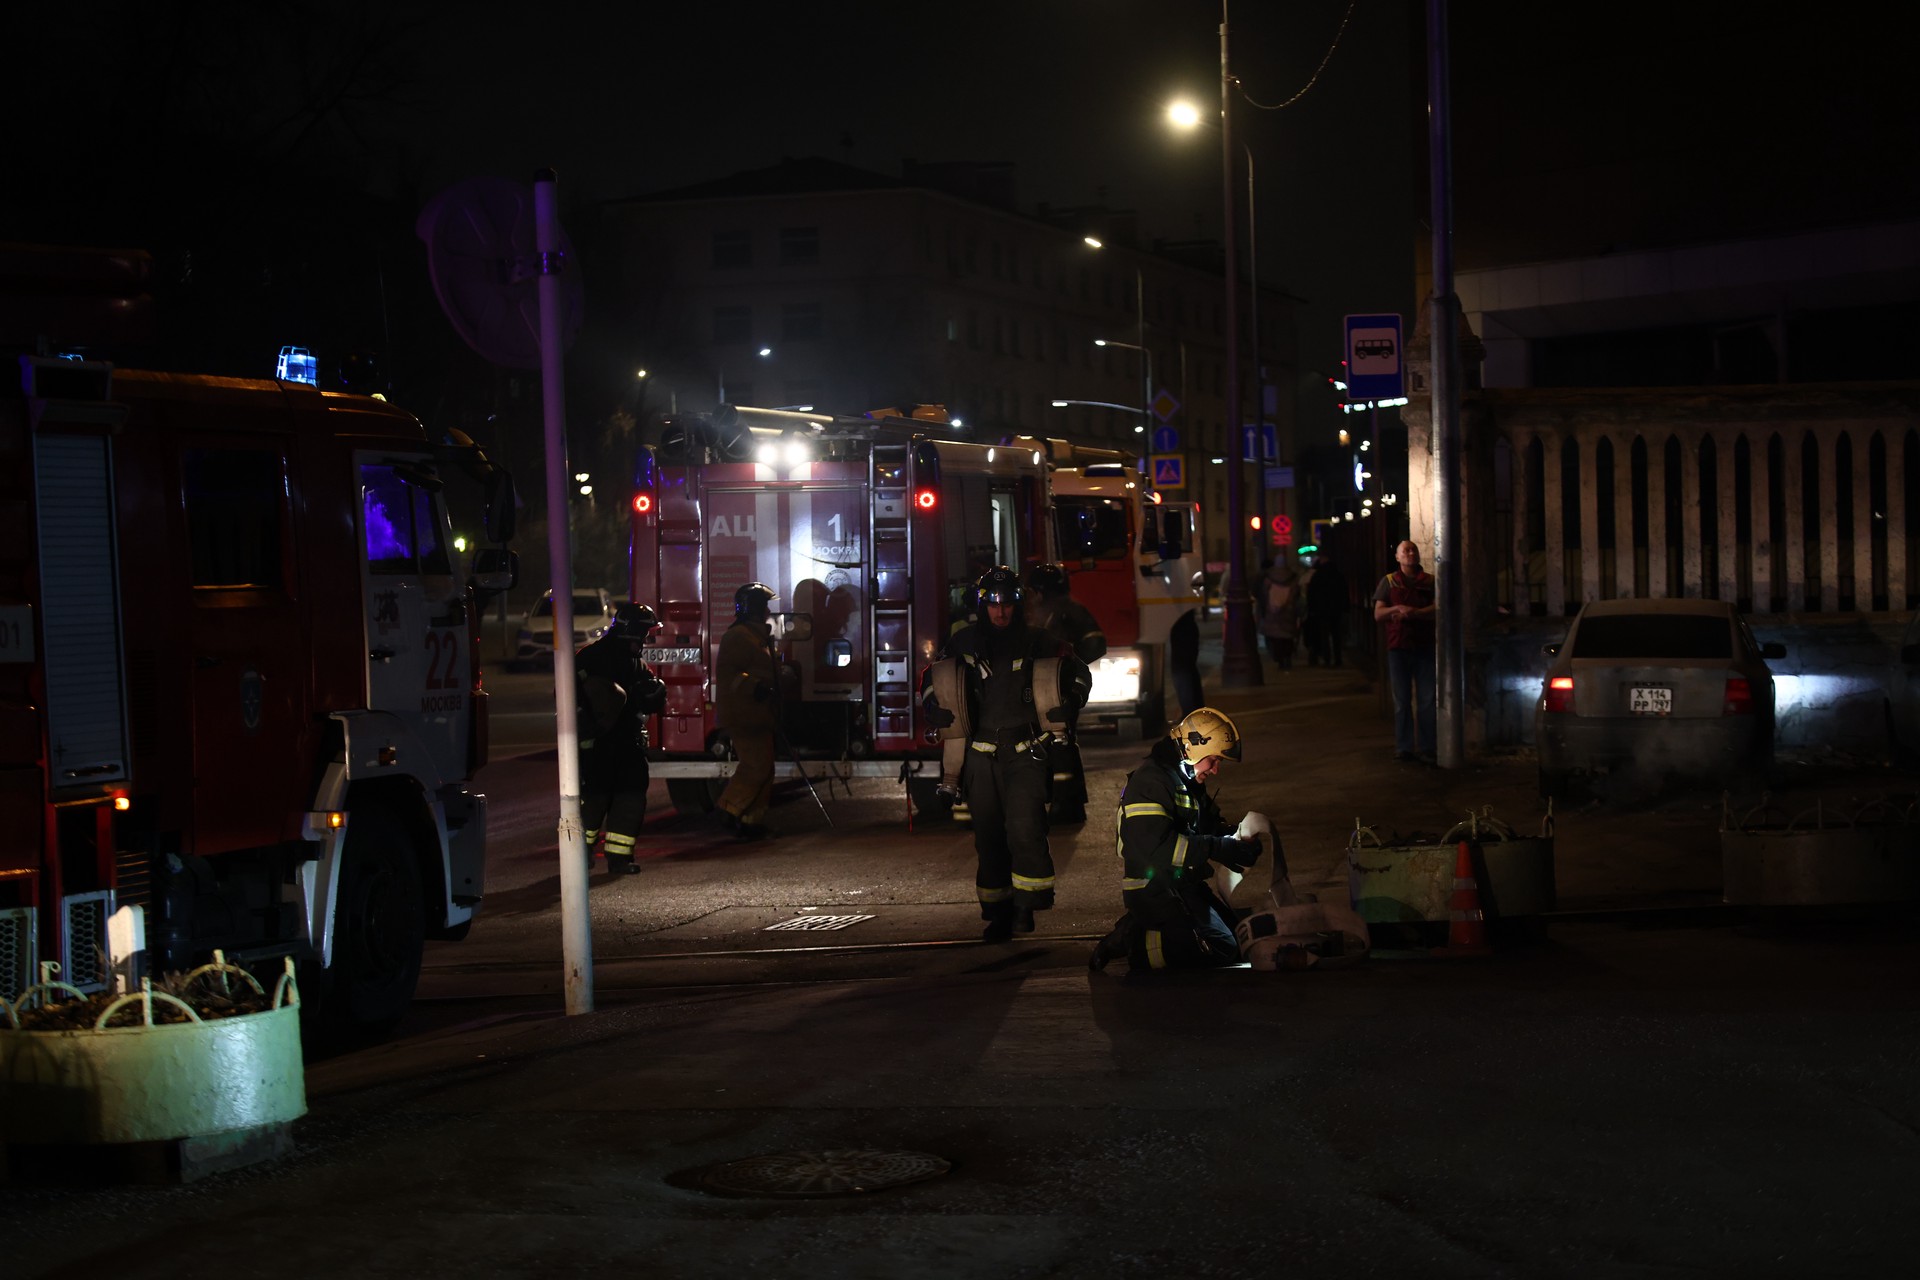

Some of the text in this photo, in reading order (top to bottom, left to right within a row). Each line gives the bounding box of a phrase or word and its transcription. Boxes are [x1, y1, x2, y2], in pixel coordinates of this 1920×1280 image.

[710, 514, 756, 541] АЦ
[827, 513, 841, 542] 1
[425, 631, 458, 689] 22
[644, 649, 678, 661] 160УР
[1647, 689, 1666, 699] 114
[1634, 700, 1649, 710] РР
